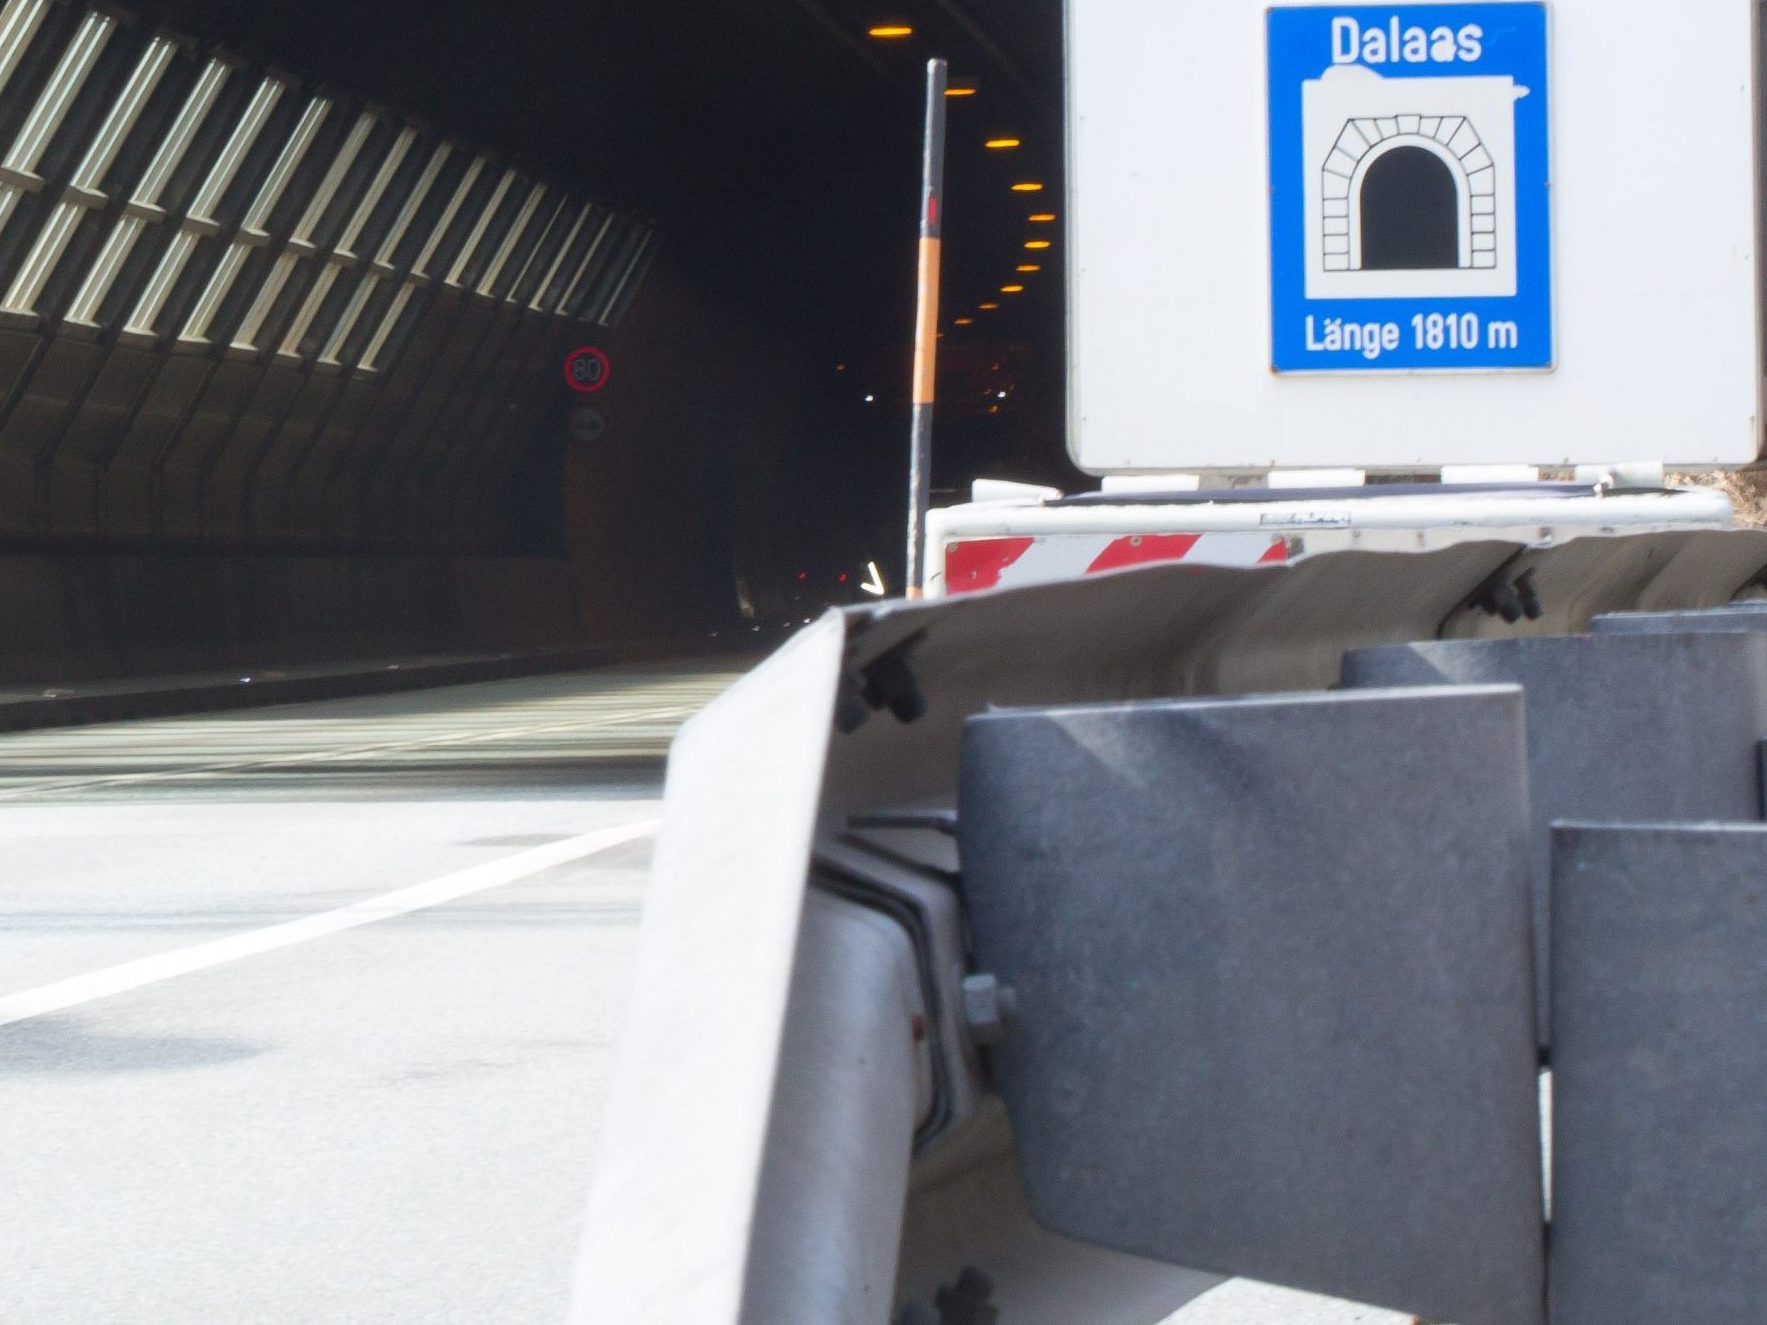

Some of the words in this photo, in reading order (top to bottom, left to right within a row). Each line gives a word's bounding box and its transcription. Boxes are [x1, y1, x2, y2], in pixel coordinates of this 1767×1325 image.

[1331, 15, 1483, 64] Dalaas
[1305, 313, 1400, 359] Länge
[1411, 312, 1479, 350] 1810
[1488, 321, 1518, 350] m
[572, 357, 602, 382] 80
